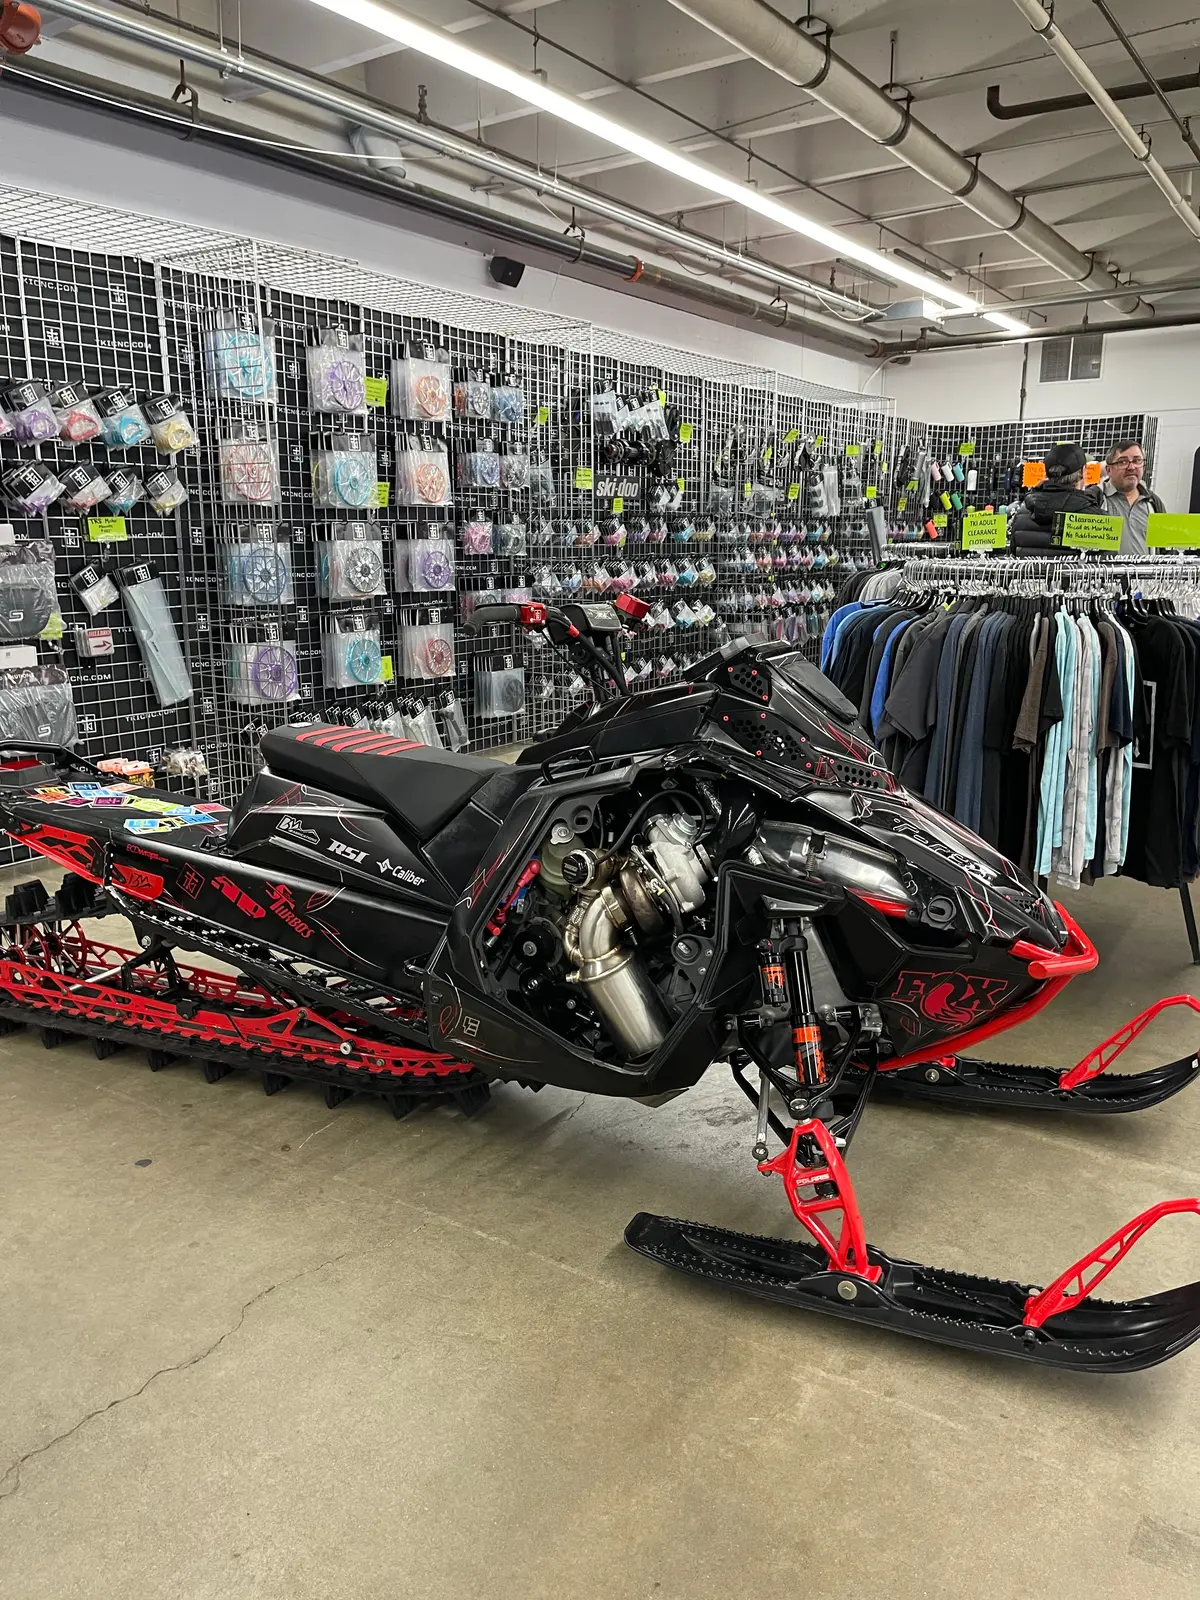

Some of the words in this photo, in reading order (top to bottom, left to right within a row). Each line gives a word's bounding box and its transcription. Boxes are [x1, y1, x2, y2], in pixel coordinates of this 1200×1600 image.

[967, 528, 998, 536] CLEARANCE
[327, 838, 370, 864] RSI
[392, 865, 426, 887] Caliber
[890, 970, 1007, 1027] FOX
[796, 1173, 830, 1186] POLARIS
